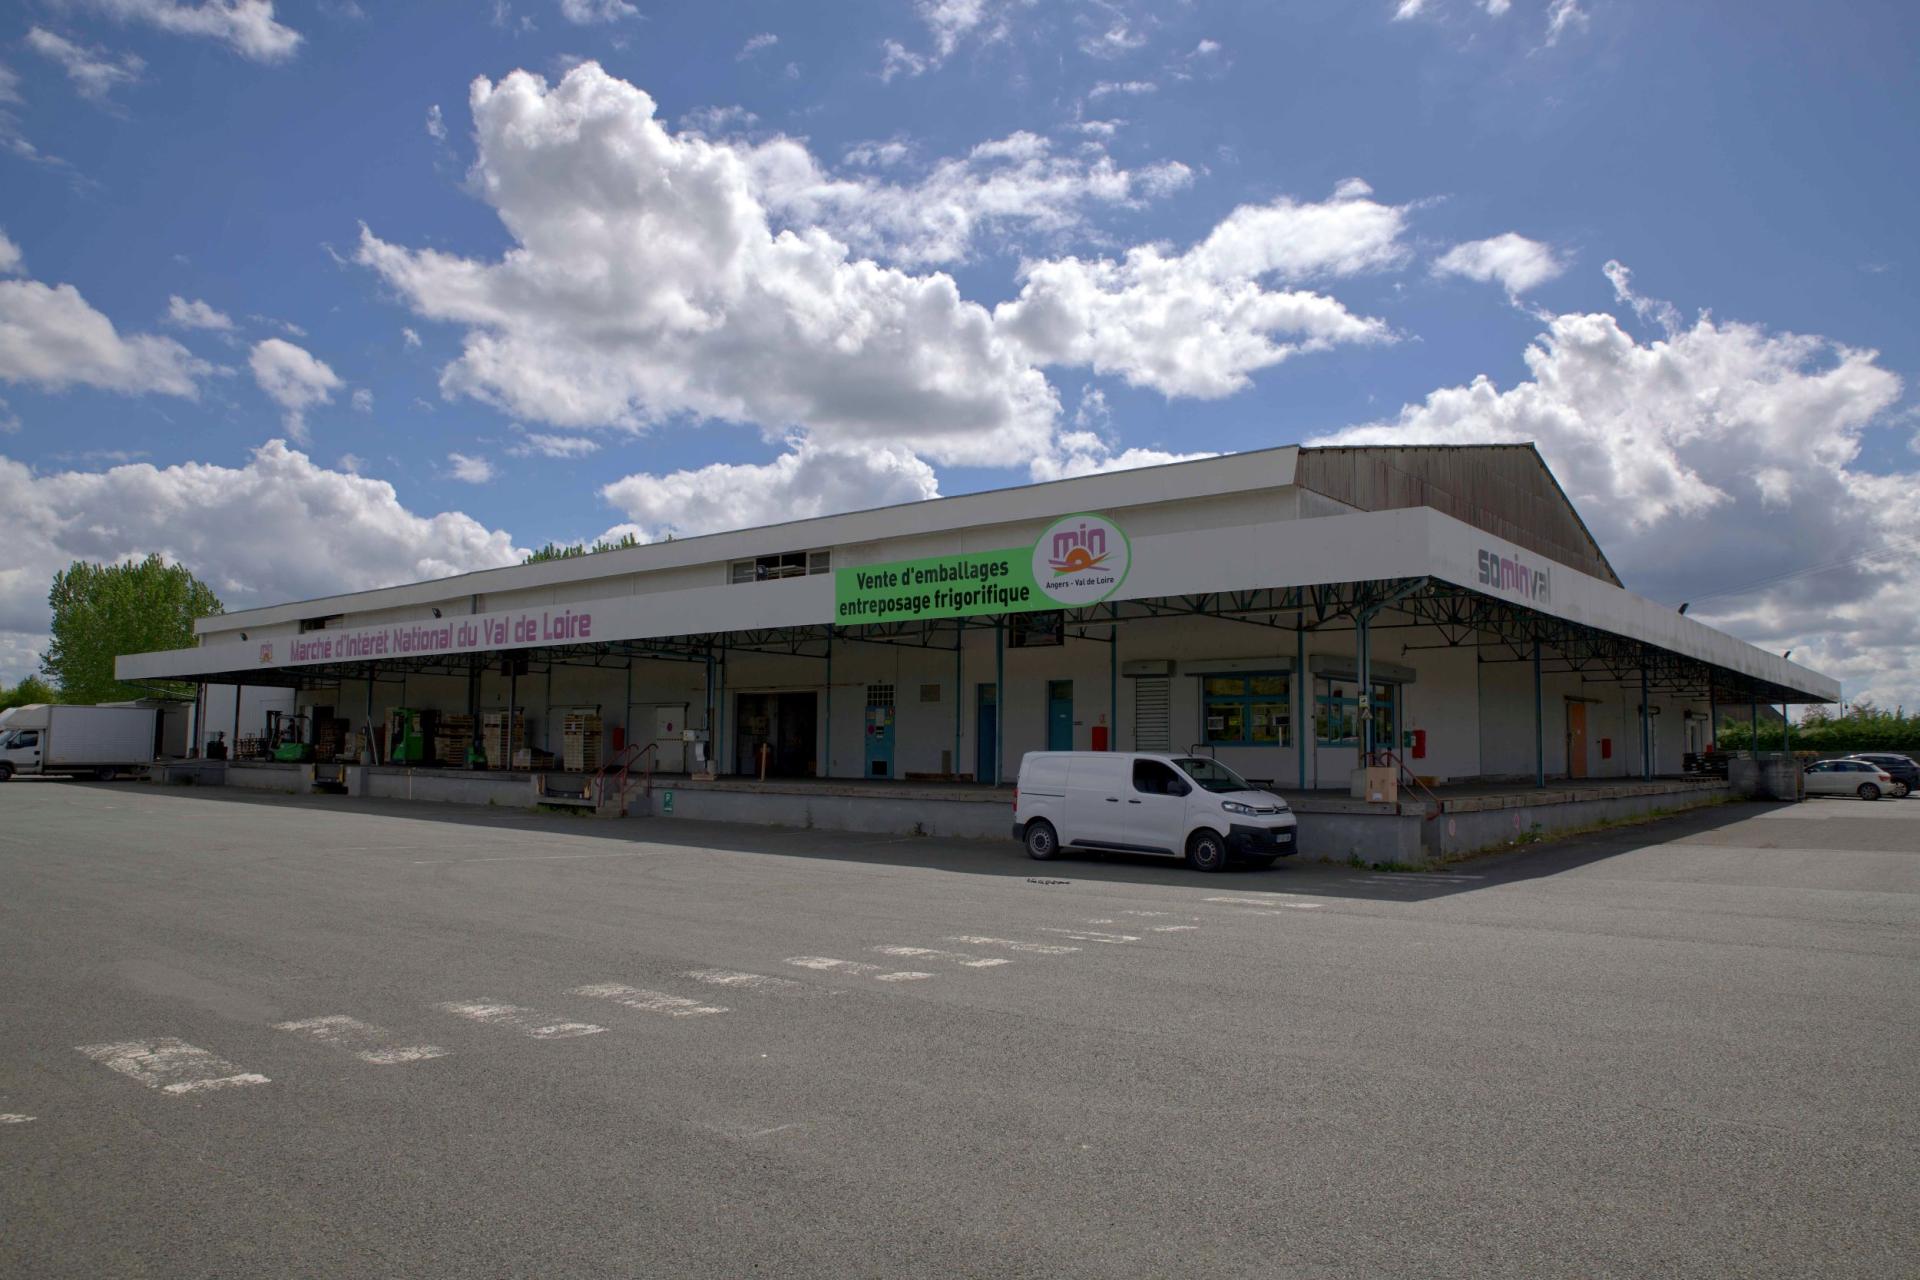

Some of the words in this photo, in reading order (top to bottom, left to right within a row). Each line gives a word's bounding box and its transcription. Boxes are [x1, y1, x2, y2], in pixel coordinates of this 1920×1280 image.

[1053, 523, 1106, 558] min
[857, 571, 897, 590] Vente
[902, 561, 1009, 586] d'emballages
[1046, 580, 1070, 590] Angers
[1075, 579, 1086, 587] Val
[1087, 578, 1096, 586] de
[1097, 576, 1114, 585] Loire
[1479, 548, 1551, 605] sominval
[840, 590, 931, 616] entreposage
[934, 584, 1030, 610] frigorifique
[290, 637, 332, 662] Marché
[393, 622, 453, 653] National
[457, 621, 478, 648] du
[484, 616, 509, 646] Val
[515, 614, 537, 643] de
[543, 609, 592, 641] Loire
